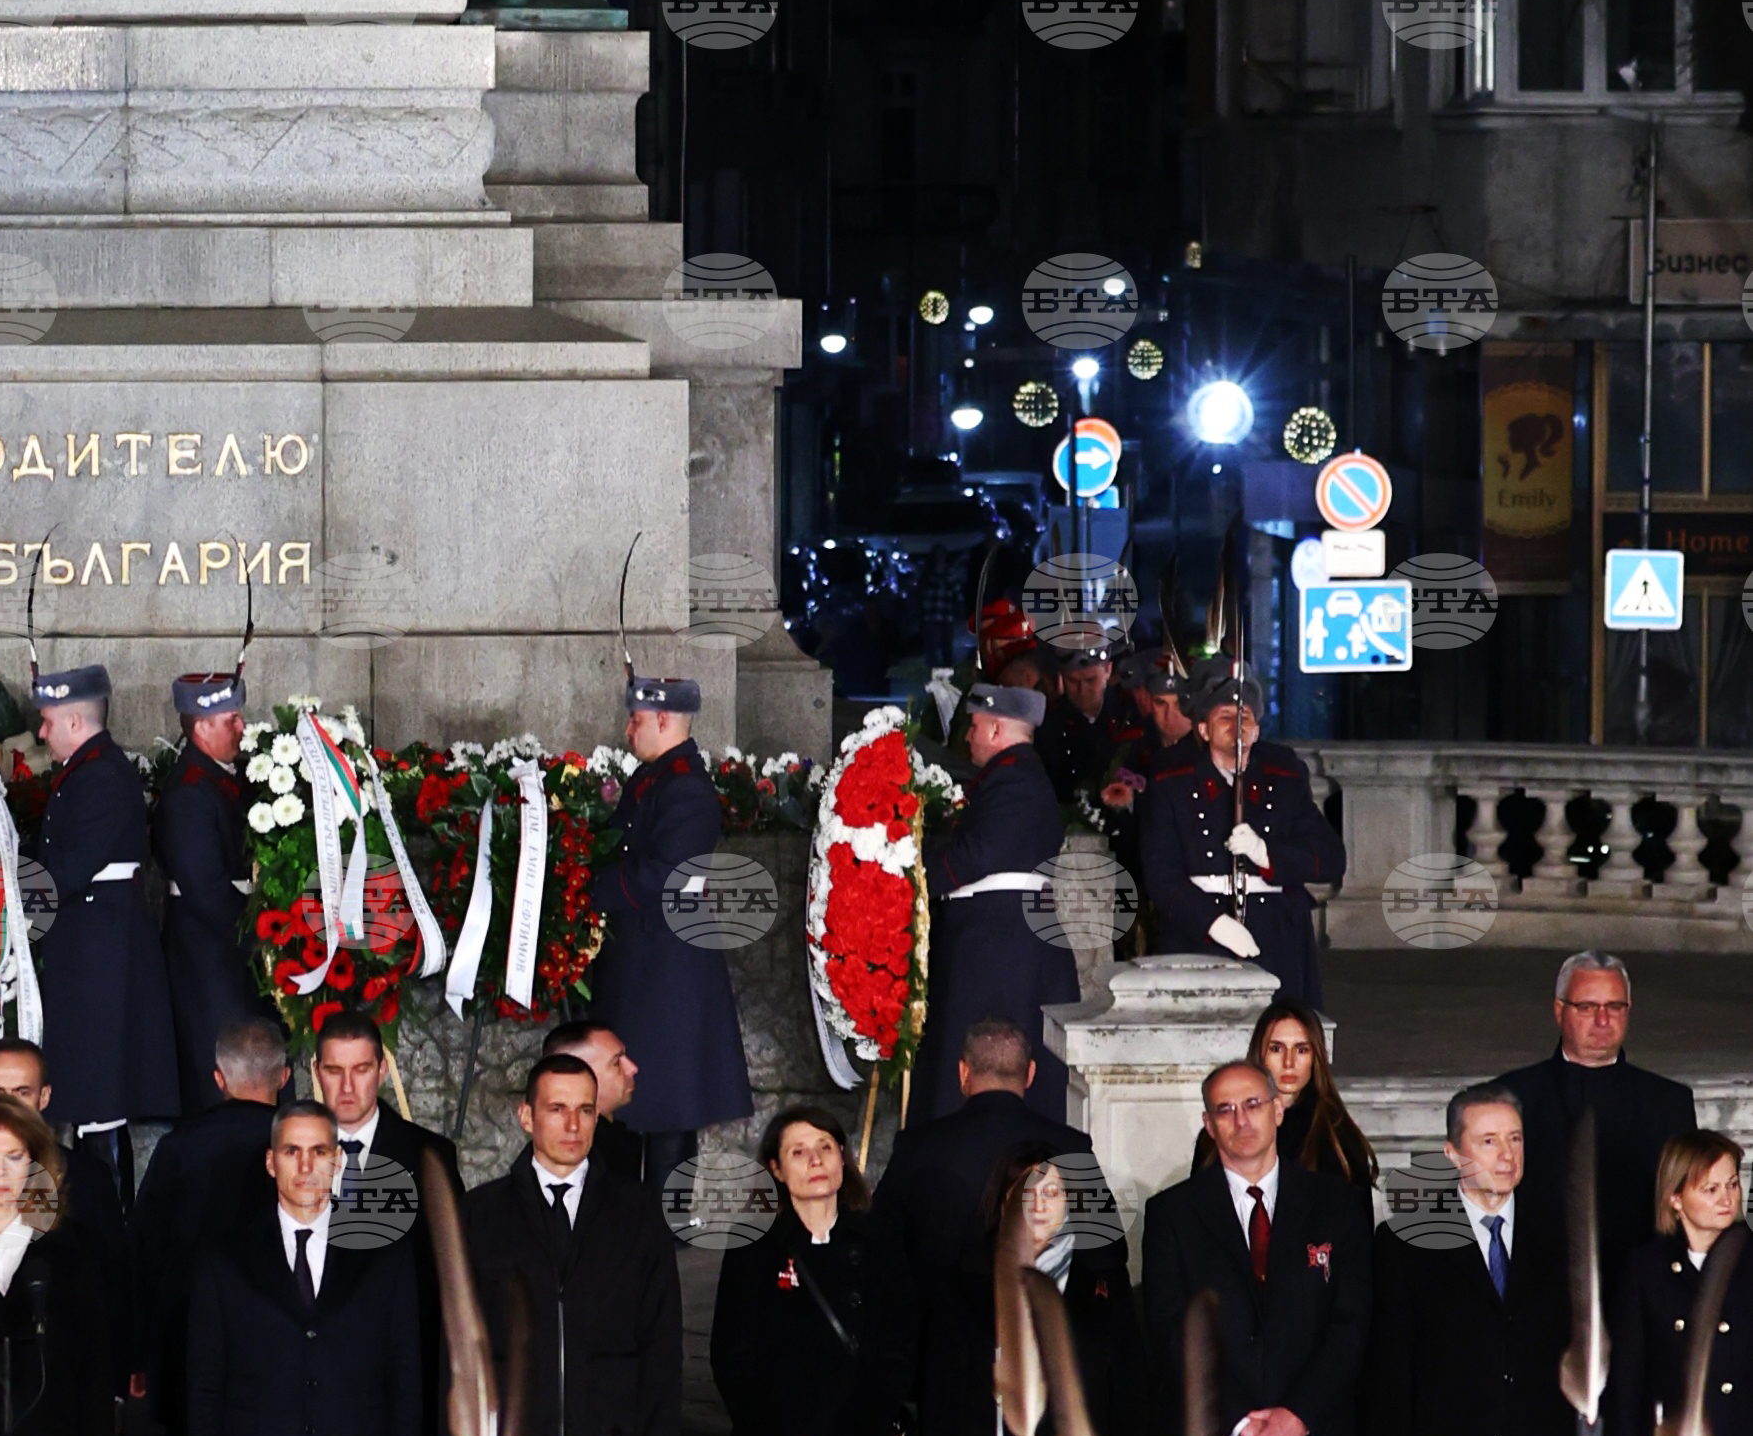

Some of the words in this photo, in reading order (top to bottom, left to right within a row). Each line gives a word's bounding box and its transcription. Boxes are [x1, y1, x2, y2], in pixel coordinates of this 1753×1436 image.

[1497, 488, 1558, 511] Emily
[1667, 529, 1750, 552] Home
[515, 899, 533, 973] ЕФТИМОВ
